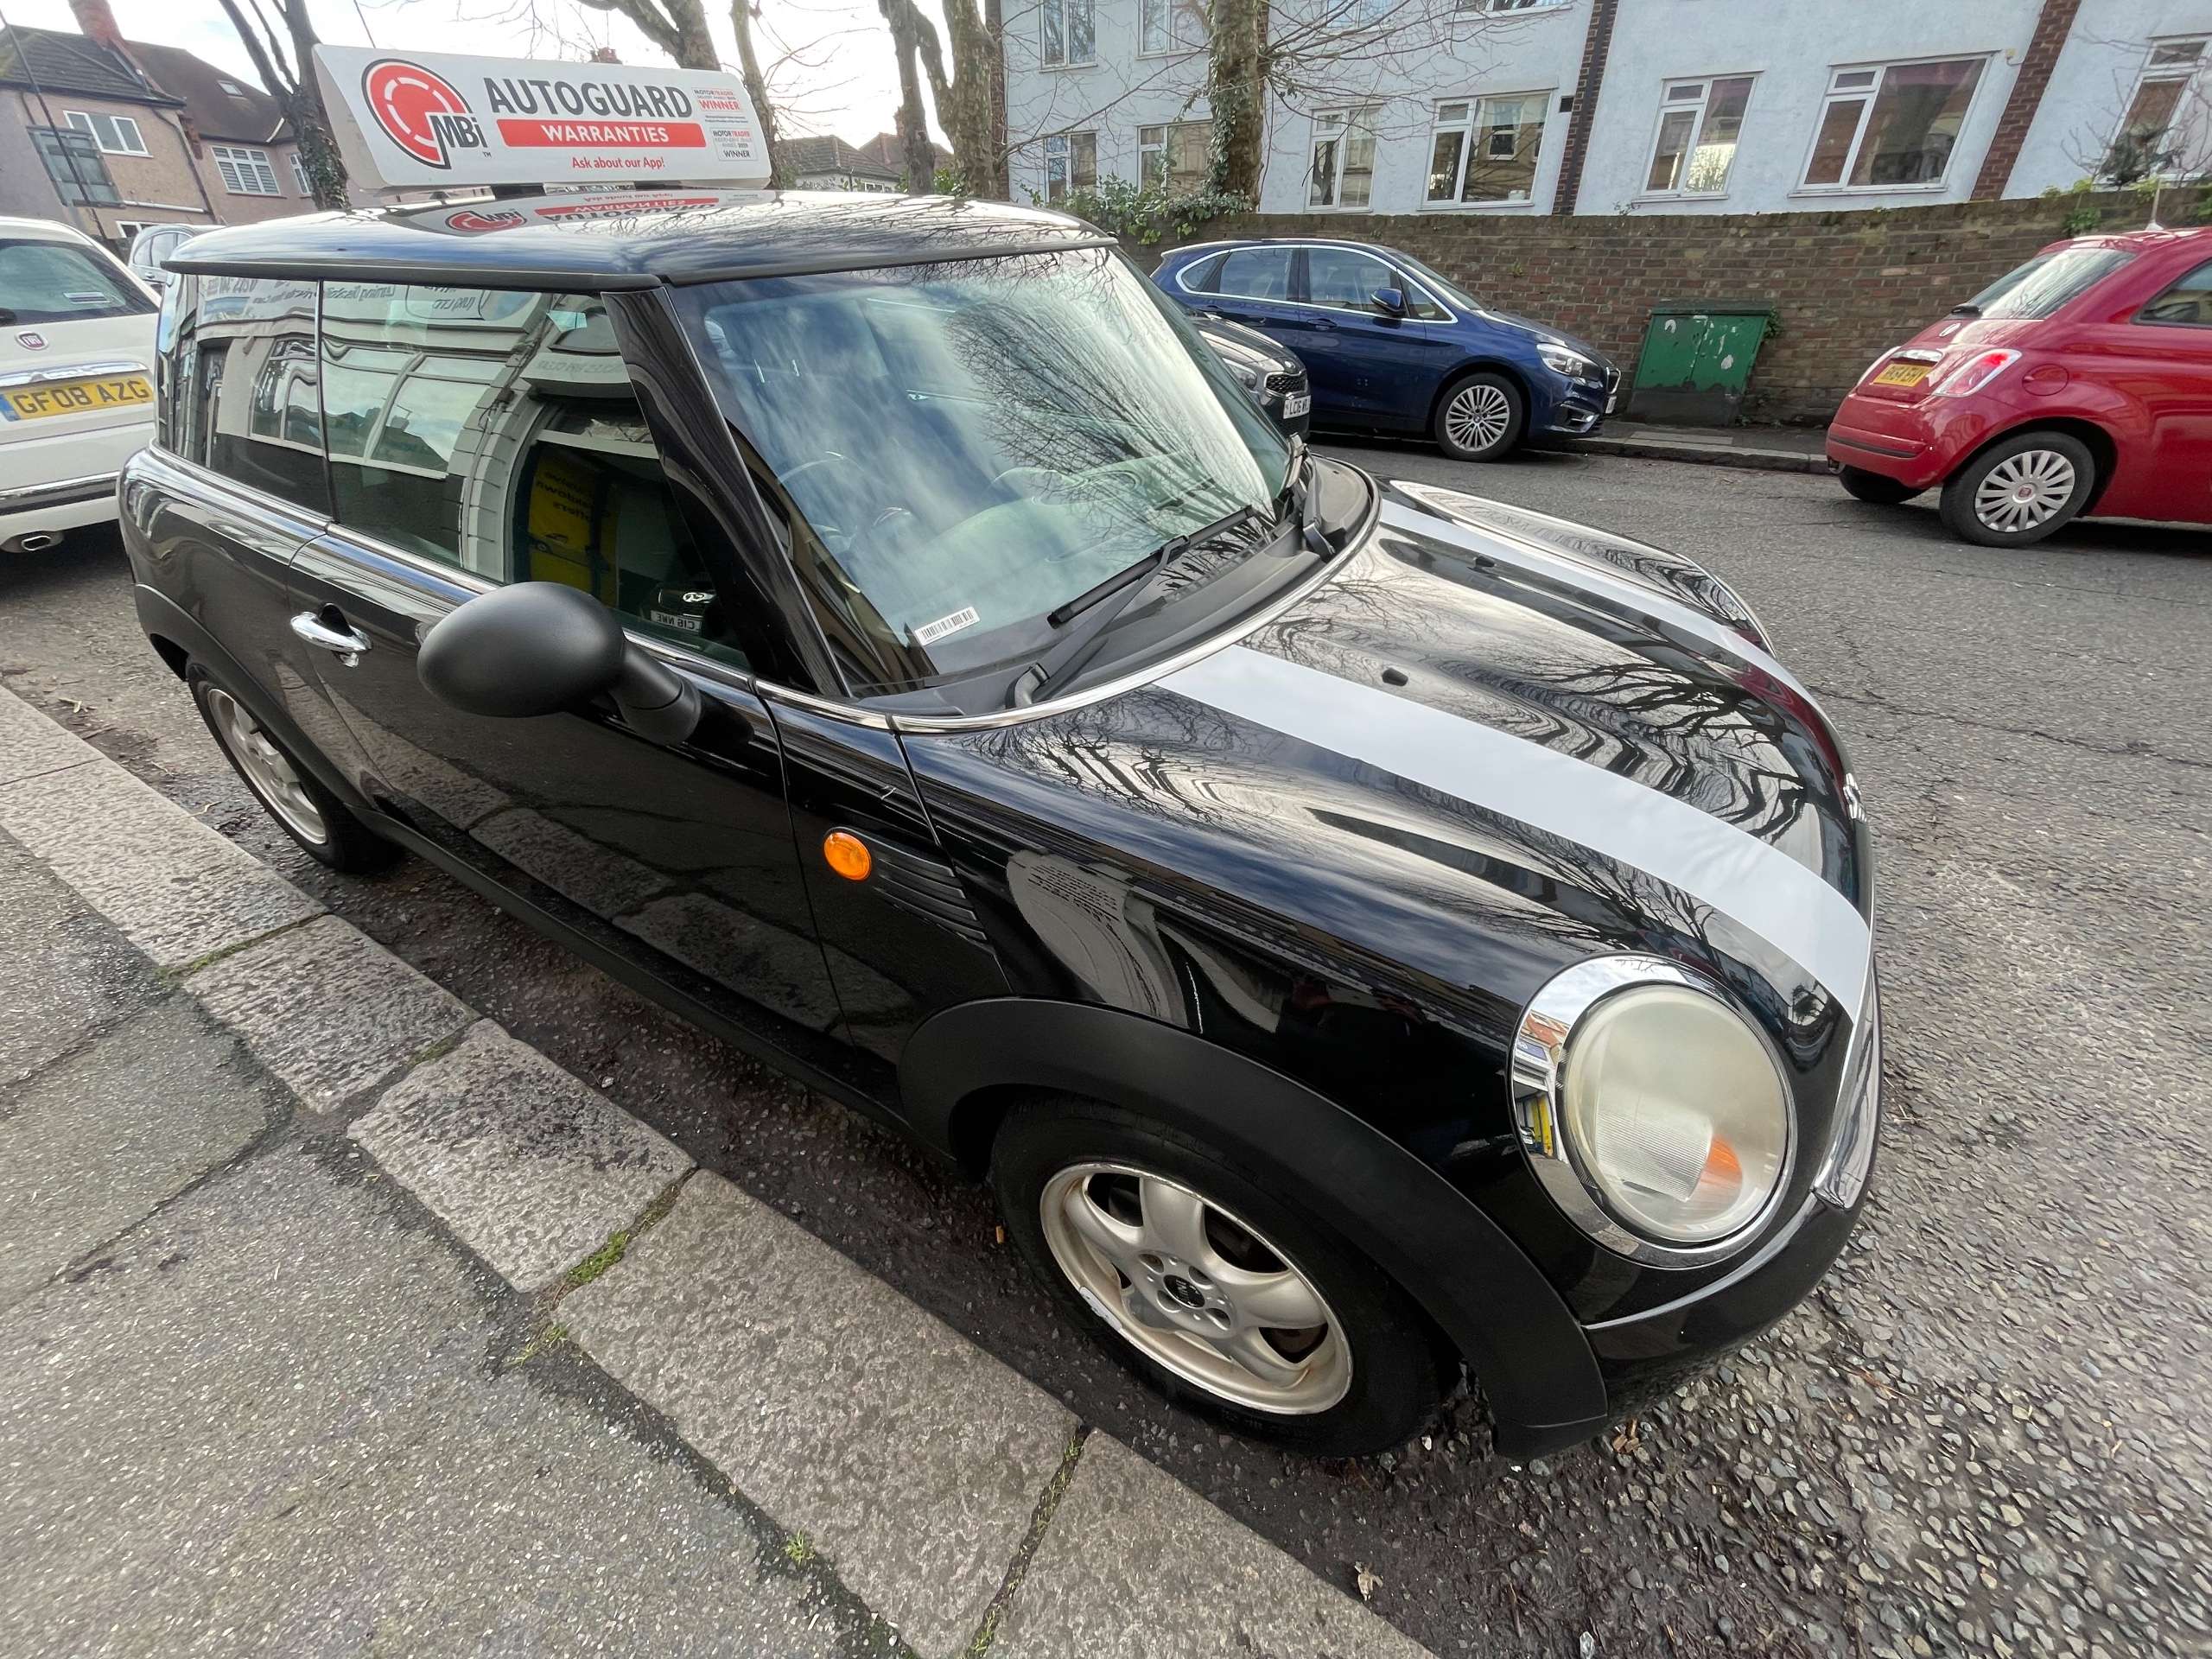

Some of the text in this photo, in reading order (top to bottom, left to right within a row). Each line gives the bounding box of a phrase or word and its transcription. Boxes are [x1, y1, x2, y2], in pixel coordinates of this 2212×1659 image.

[484, 78, 693, 118] AUTOGUARD
[699, 99, 741, 111] WINNER
[540, 124, 670, 143] WARRANTIES
[723, 149, 752, 158] WINNER
[572, 156, 665, 169] Ask about our App!
[13, 380, 149, 414] GF08 AZG
